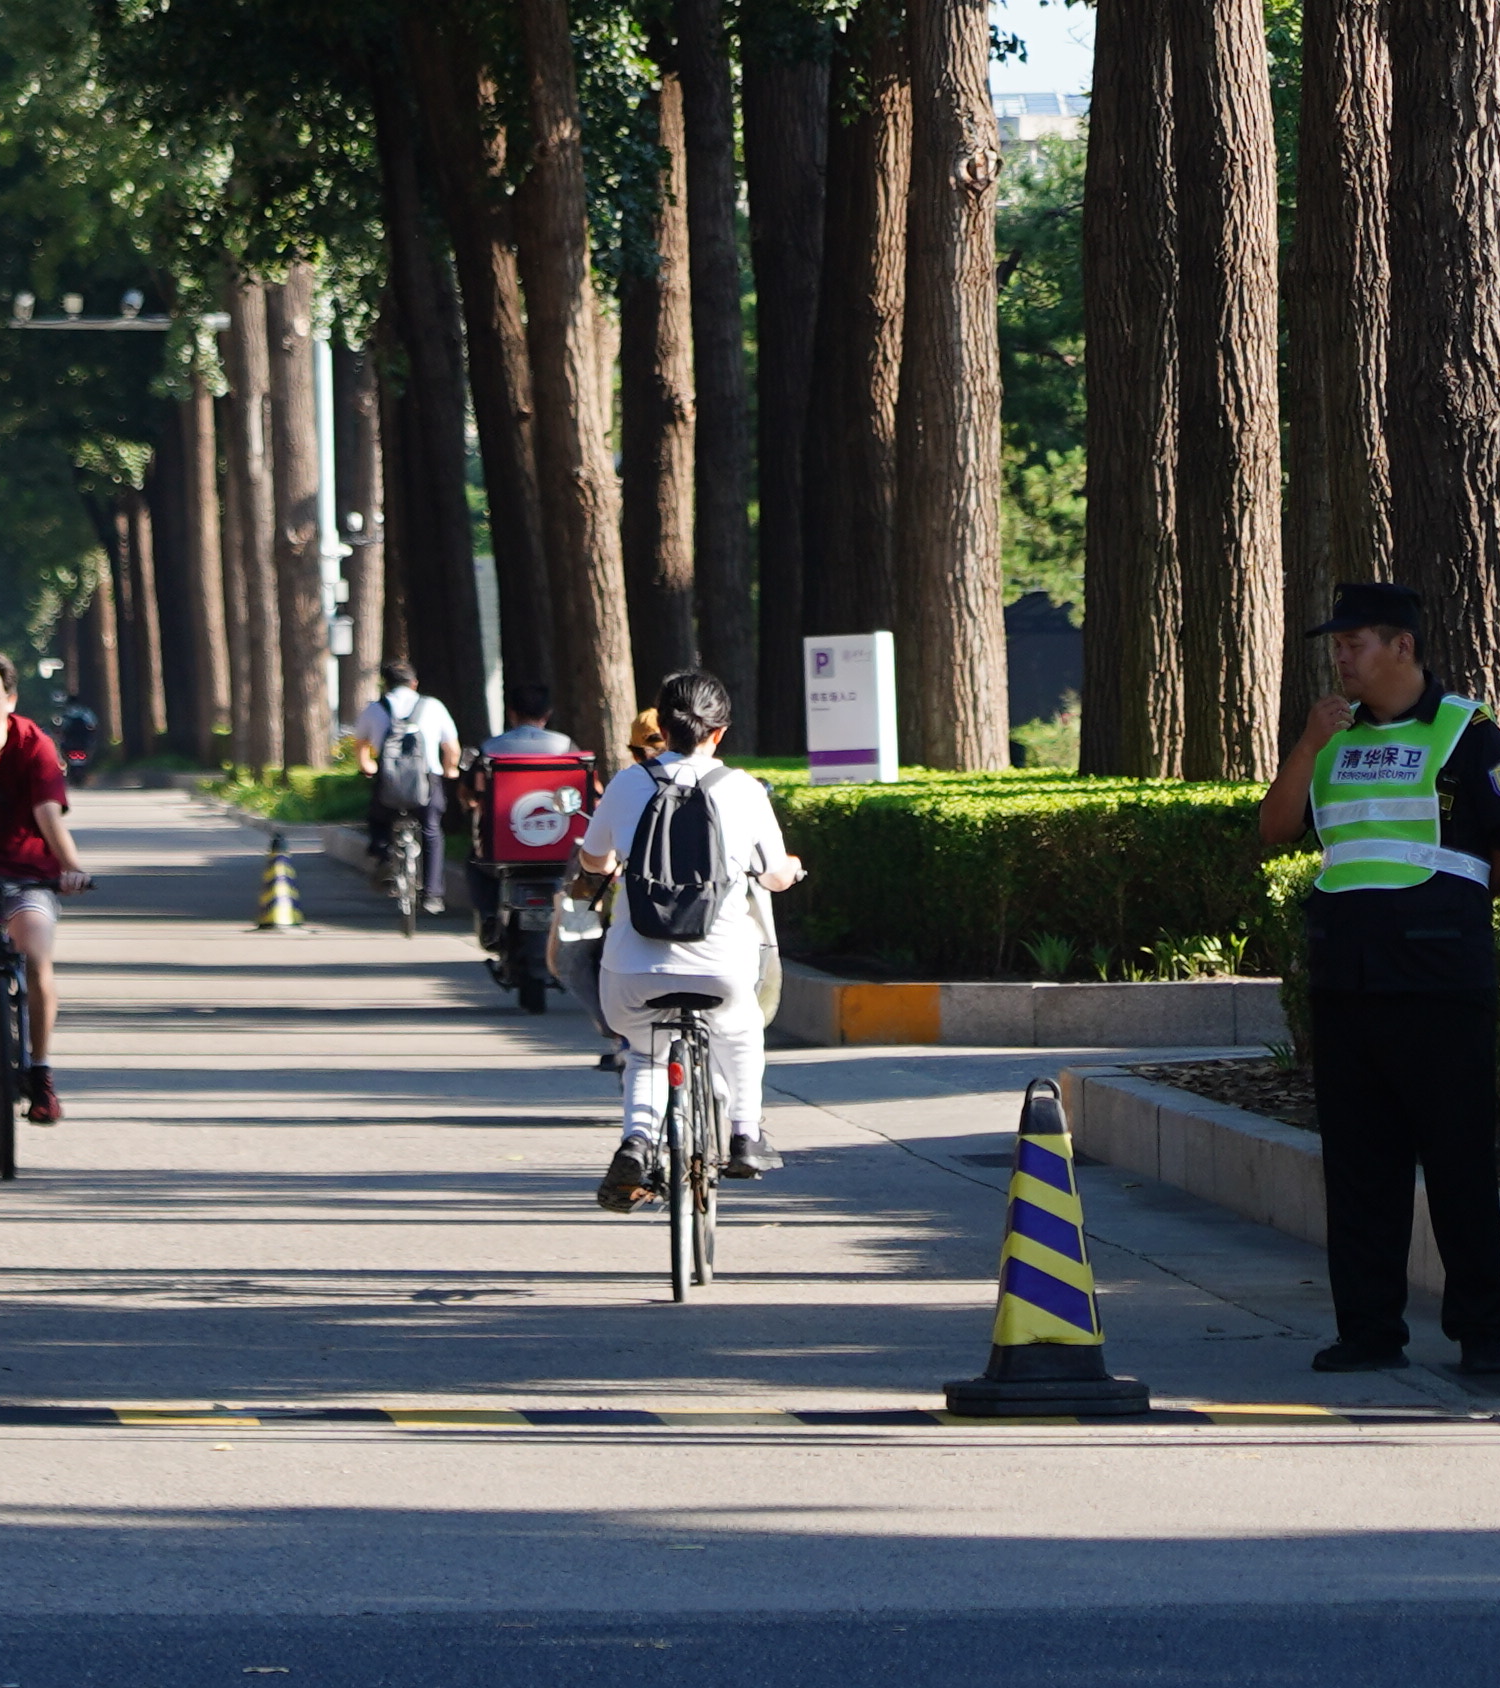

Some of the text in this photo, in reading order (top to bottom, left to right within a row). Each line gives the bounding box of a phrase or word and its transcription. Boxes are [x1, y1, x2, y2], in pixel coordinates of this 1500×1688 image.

[815, 652, 829, 675] P
[1341, 747, 1422, 769] 清华保卫
